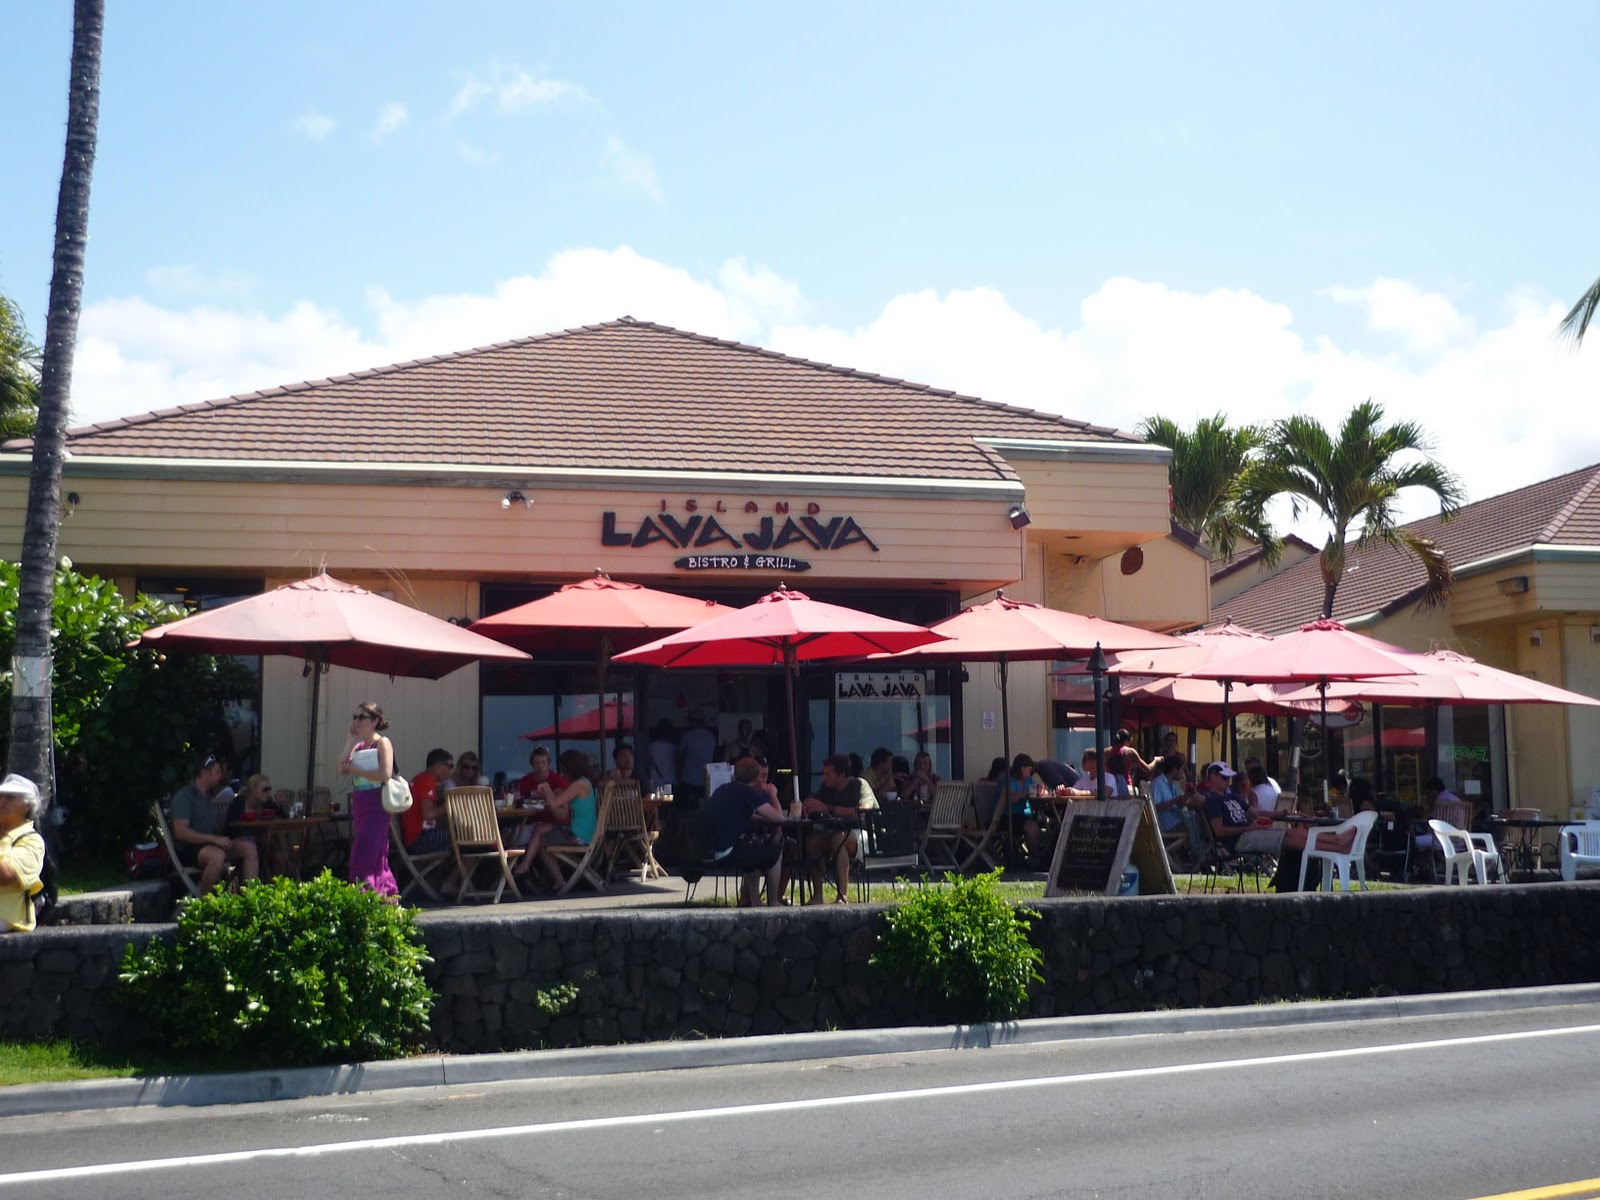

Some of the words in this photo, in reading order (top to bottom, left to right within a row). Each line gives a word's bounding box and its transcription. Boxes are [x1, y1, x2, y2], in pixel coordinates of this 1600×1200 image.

[660, 499, 821, 515] ISLAND
[601, 511, 743, 549] LAVA
[742, 515, 880, 552] JAVA
[688, 556, 738, 569] BISTRO
[743, 554, 750, 569] &
[755, 556, 796, 569] GRILL
[838, 682, 879, 698] LAVA
[881, 682, 921, 698] JAVA
